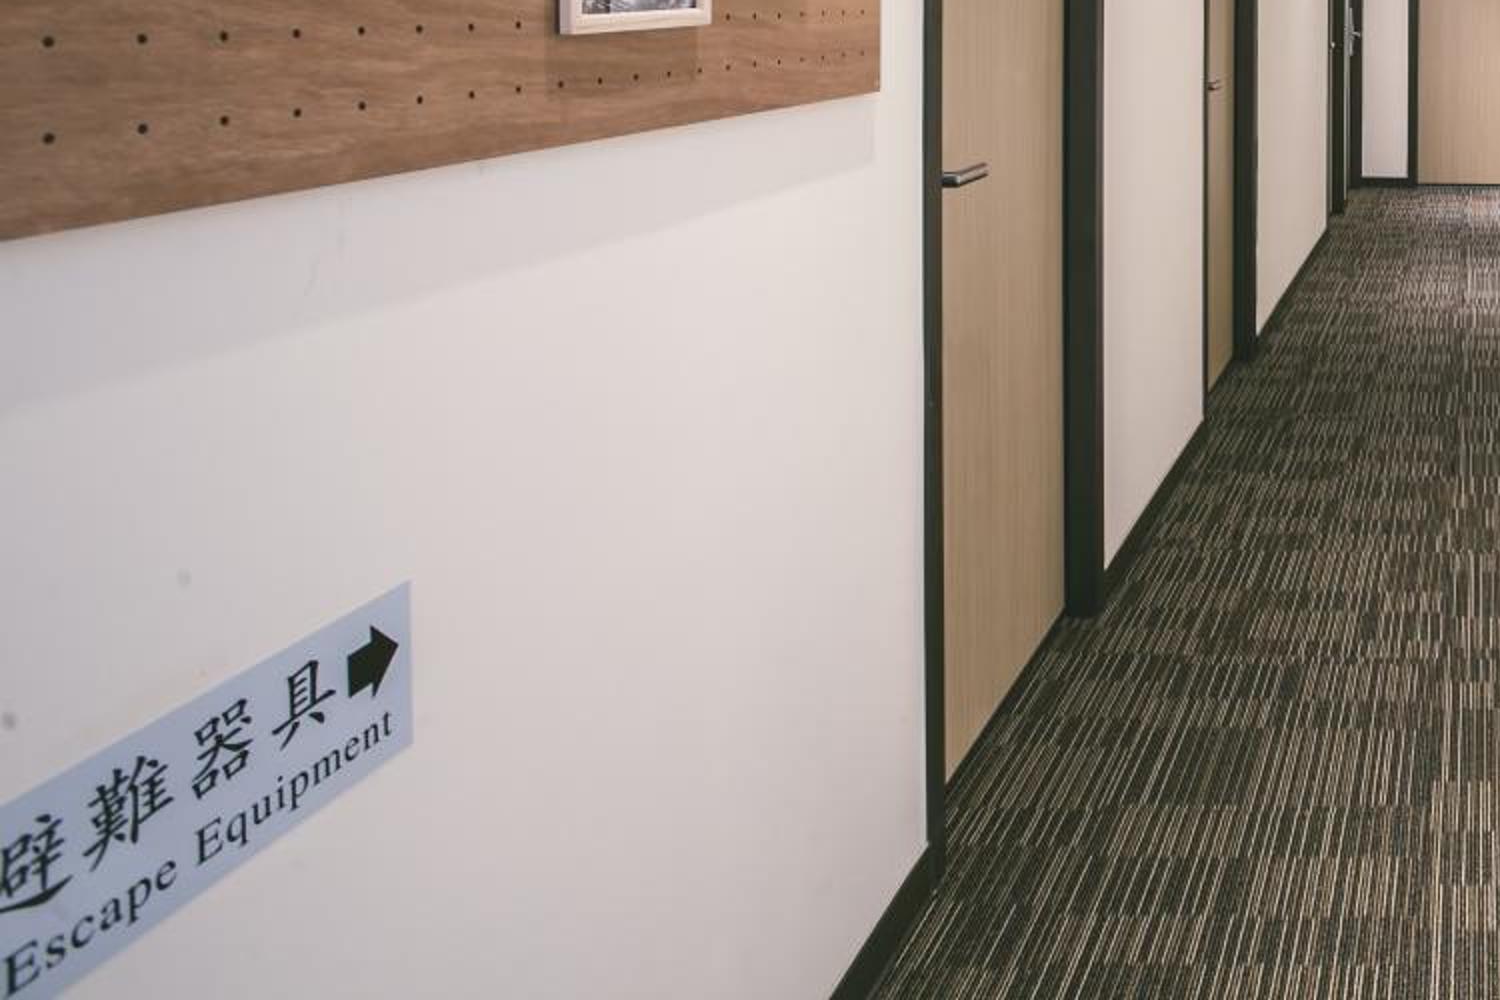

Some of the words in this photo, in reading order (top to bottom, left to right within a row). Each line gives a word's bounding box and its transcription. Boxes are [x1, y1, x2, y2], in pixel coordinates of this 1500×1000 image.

[0, 660, 337, 914] 避難器具
[2, 859, 178, 998] Escape
[194, 711, 393, 867] Equipment
